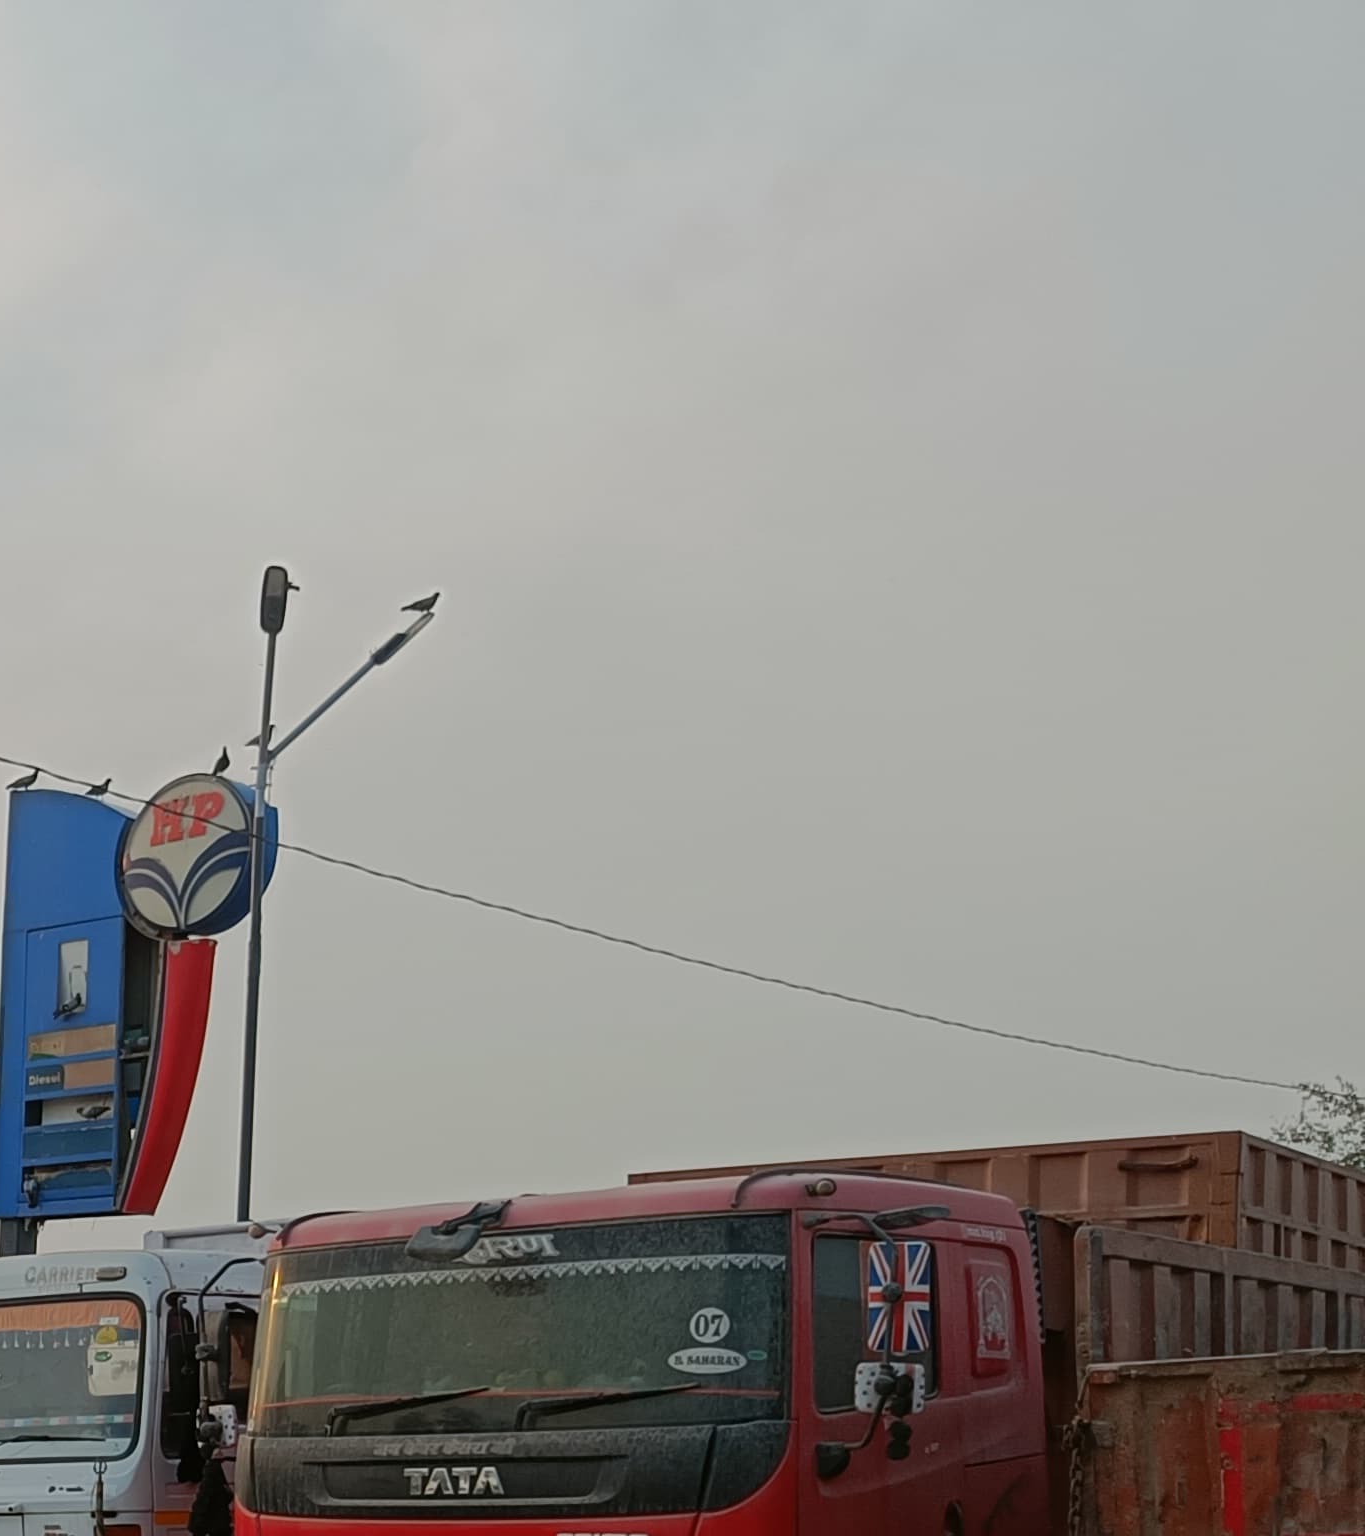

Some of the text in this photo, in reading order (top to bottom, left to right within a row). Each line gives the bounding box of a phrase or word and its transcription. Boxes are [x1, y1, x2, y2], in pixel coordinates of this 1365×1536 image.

[150, 791, 225, 847] HP
[28, 1071, 61, 1087] Diesel
[24, 1266, 96, 1286] CARRIER
[694, 1313, 725, 1338] 07
[403, 1467, 505, 1496] TATA
